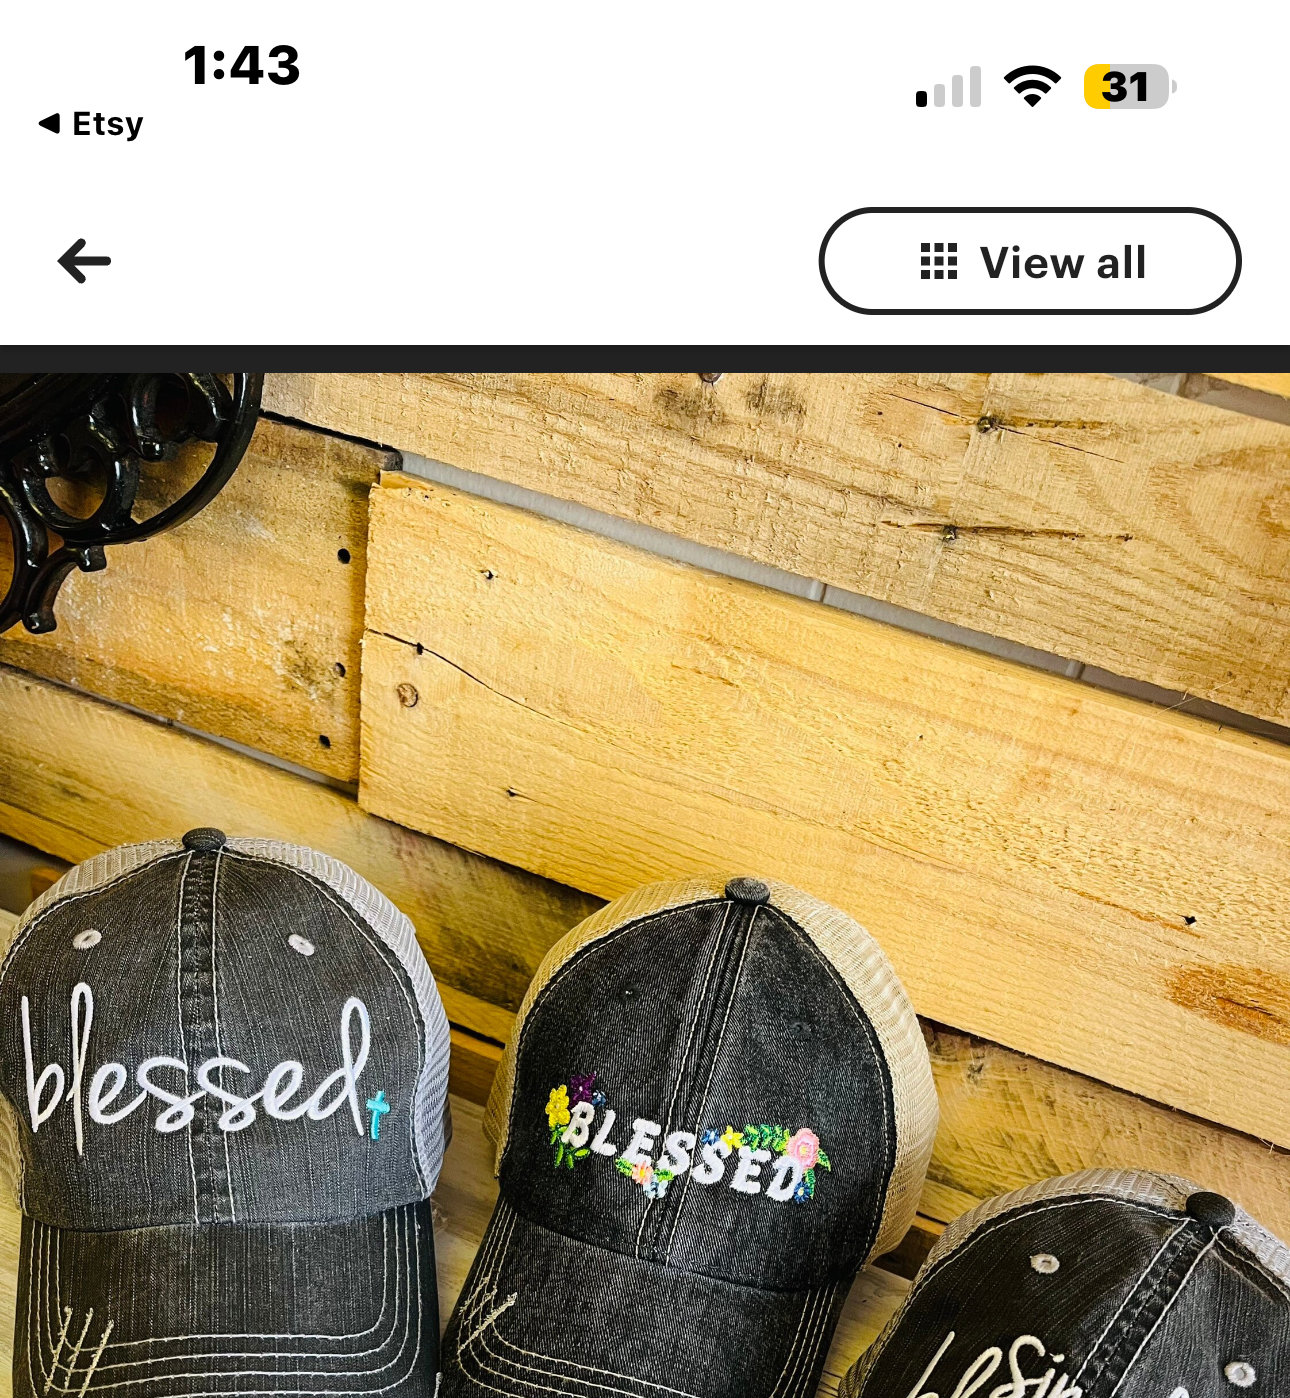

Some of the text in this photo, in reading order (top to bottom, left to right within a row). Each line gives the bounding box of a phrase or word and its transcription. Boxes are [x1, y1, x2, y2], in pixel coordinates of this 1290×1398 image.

[184, 44, 300, 86] 1:43
[1101, 70, 1147, 103] 31
[73, 111, 144, 142] Etsy
[979, 244, 1146, 279] View all
[22, 982, 371, 1156] blessed
[561, 1100, 802, 1202] BLESSED
